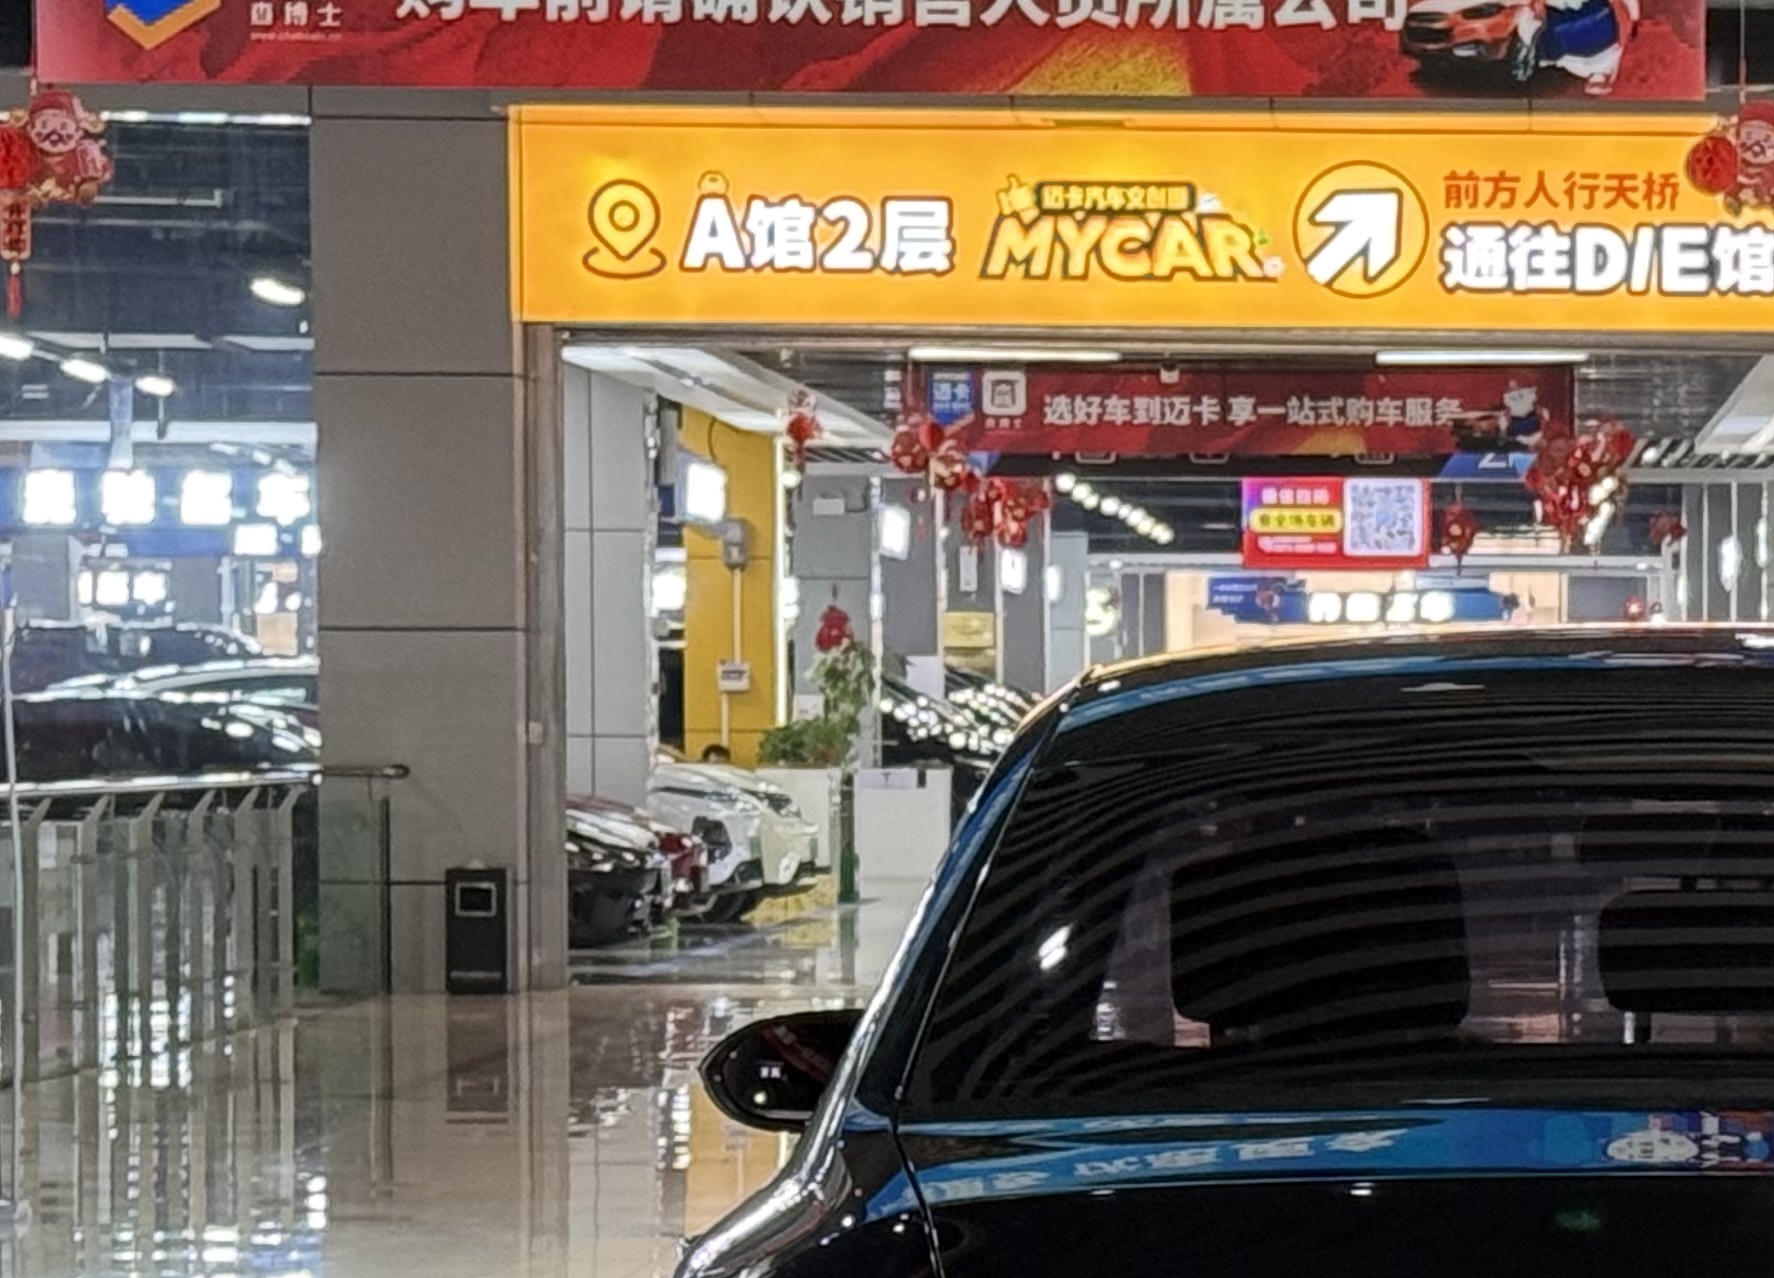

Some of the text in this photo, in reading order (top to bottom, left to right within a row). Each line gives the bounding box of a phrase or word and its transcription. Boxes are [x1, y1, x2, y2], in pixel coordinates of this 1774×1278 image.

[1443, 170, 1680, 211] 前方人行天桥
[679, 194, 955, 273] A馆2层
[983, 213, 1270, 280] MYCAR
[1043, 395, 1222, 426] 选好车到迈卡
[1227, 396, 1463, 428] 享一站式购车服务
